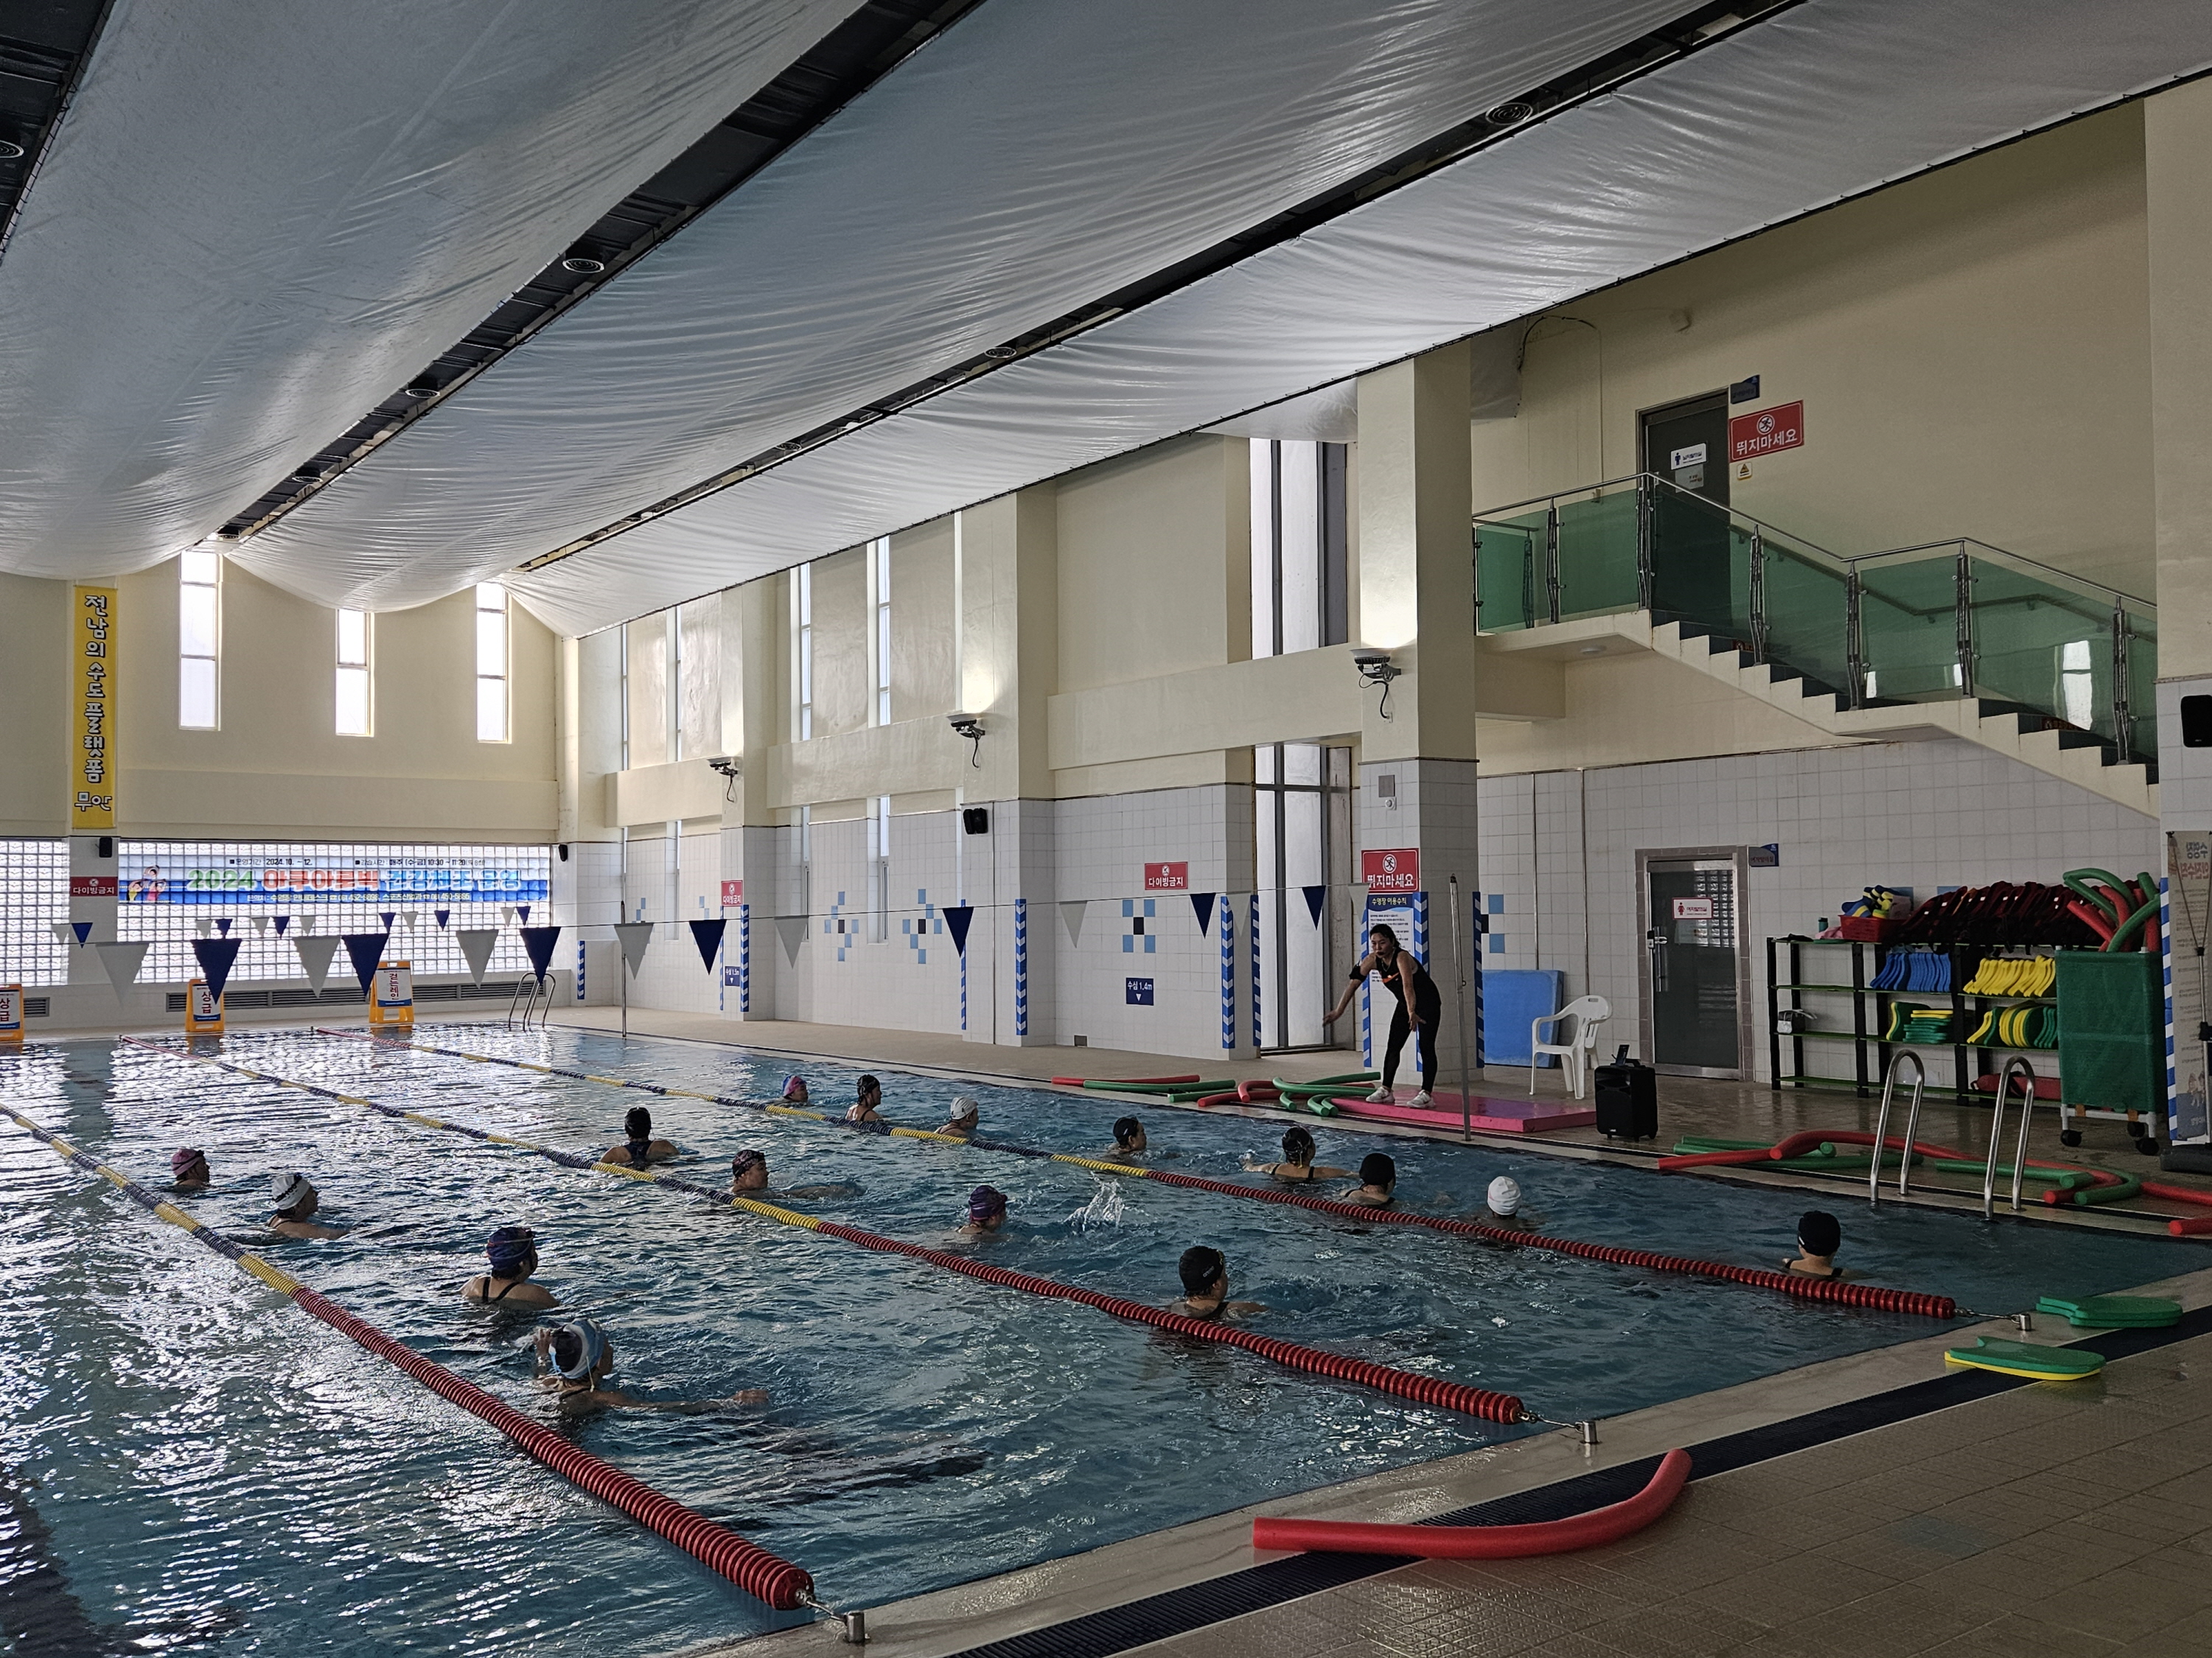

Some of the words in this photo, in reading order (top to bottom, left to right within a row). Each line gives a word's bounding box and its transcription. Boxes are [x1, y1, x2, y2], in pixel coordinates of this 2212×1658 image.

[1736, 429, 1798, 455] 뛰지마세요
[74, 791, 113, 812] 무안
[187, 869, 256, 890] 2024
[262, 869, 380, 892] 아쿠아로빅
[387, 869, 472, 891] 건강체조
[479, 869, 520, 891] 운영
[1148, 876, 1183, 887] 다이빙금지
[1367, 873, 1414, 889] 뛰지마세요
[72, 886, 115, 895] 다이빙금지
[723, 895, 742, 904] 다이빙금지
[1372, 898, 1386, 906] 수영장
[1386, 897, 1407, 906] 이용수칙
[1127, 981, 1138, 990] 수심
[1139, 982, 1153, 991] 1.4m
[0, 998, 11, 1022] 상급
[201, 991, 212, 1014] 상급
